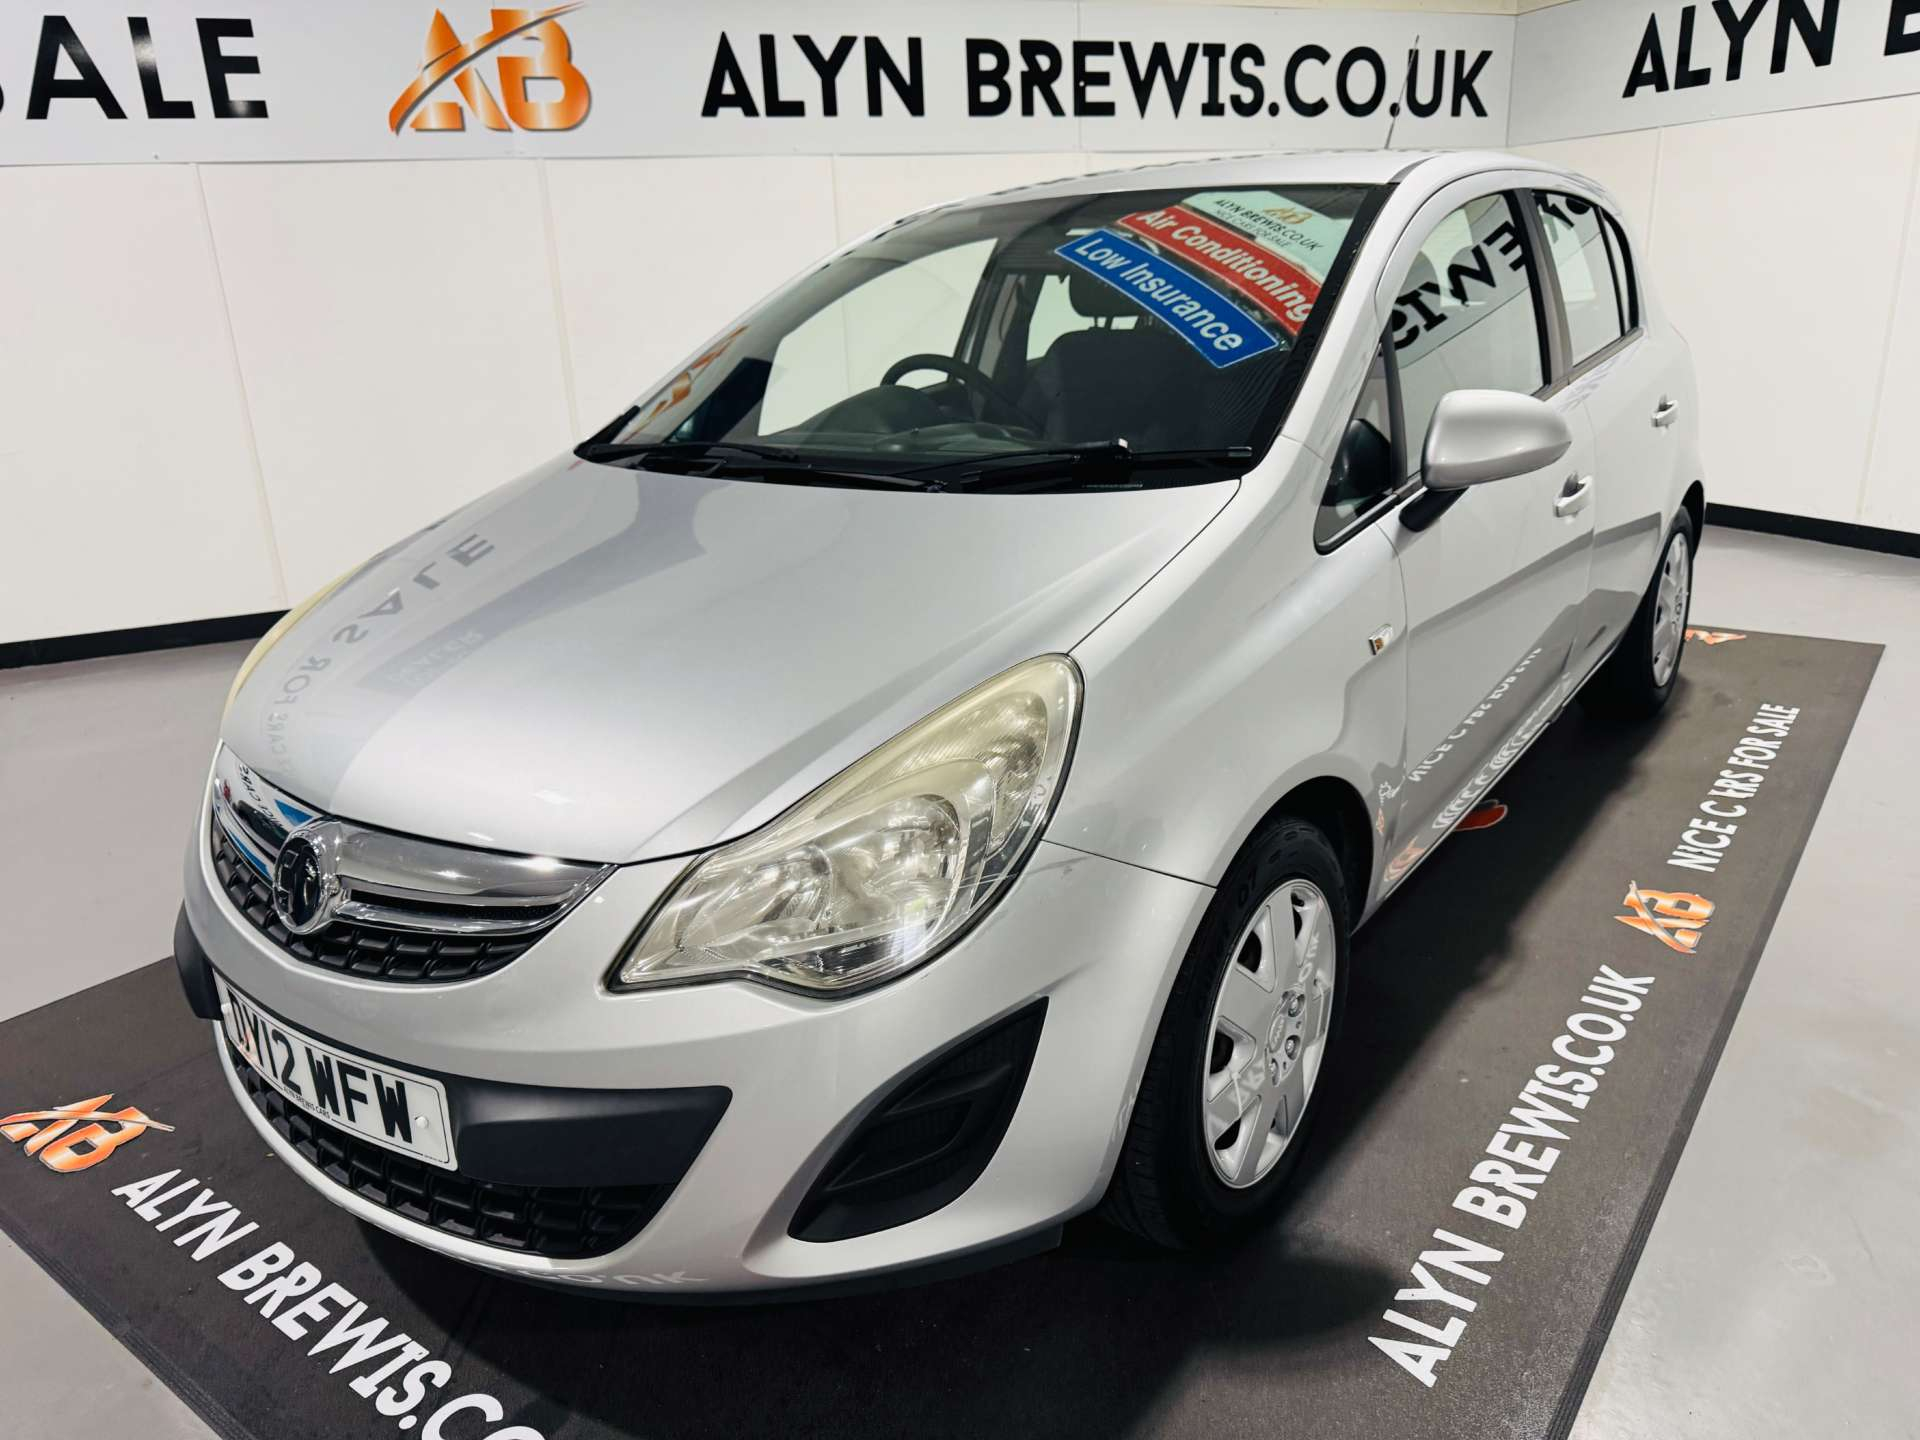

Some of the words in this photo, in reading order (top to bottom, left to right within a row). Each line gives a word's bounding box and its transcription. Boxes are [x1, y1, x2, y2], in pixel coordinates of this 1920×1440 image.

[0, 15, 268, 119] ALE
[701, 31, 925, 118] ALYN
[966, 38, 1493, 119] BREWIS.CO.UK
[1622, 0, 1840, 98] ALYN
[1075, 238, 1130, 271] Low
[1123, 261, 1244, 352] Insurance
[1136, 211, 1165, 231] Air
[1171, 223, 1313, 322] Conditioning
[1728, 736, 1782, 769] FOR
[1746, 703, 1800, 737] SALE
[1667, 818, 1738, 873] NICE
[227, 987, 302, 1097] DY12
[305, 1046, 413, 1145] WFW
[1368, 1228, 1504, 1388] ALYN
[1452, 964, 1656, 1229] BREWIS.CO.UK
[111, 1169, 259, 1261] ALYN
[217, 1241, 546, 1440] BREWIS.C
